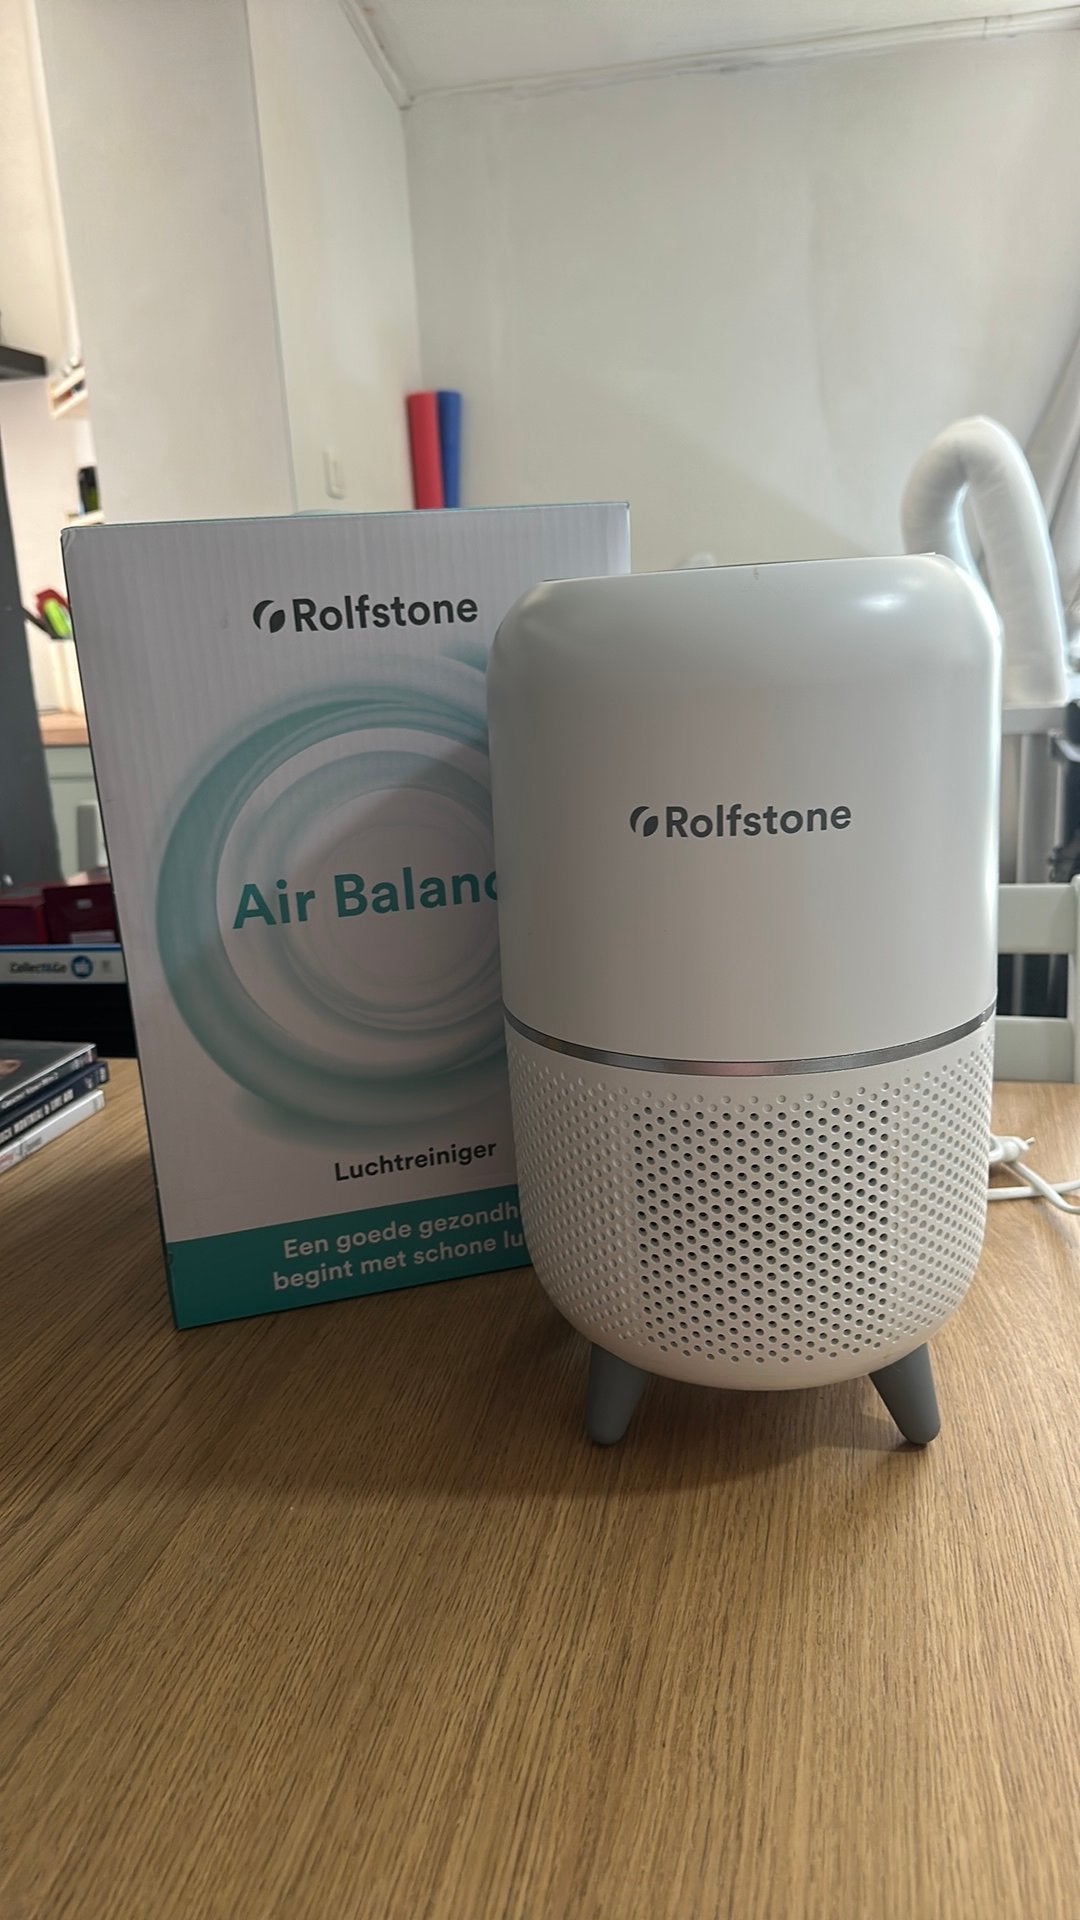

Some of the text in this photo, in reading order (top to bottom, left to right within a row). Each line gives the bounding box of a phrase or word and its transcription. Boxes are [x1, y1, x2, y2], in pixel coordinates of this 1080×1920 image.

[292, 594, 478, 632] Rolfstone
[666, 803, 851, 838] Rolfstone
[232, 879, 315, 929] Air
[334, 1142, 497, 1181] Luchtreiniger
[283, 1237, 329, 1259] Een
[336, 1221, 412, 1253] goede
[273, 1260, 353, 1291] begint
[360, 1250, 407, 1275] met
[413, 1237, 497, 1265] schone
